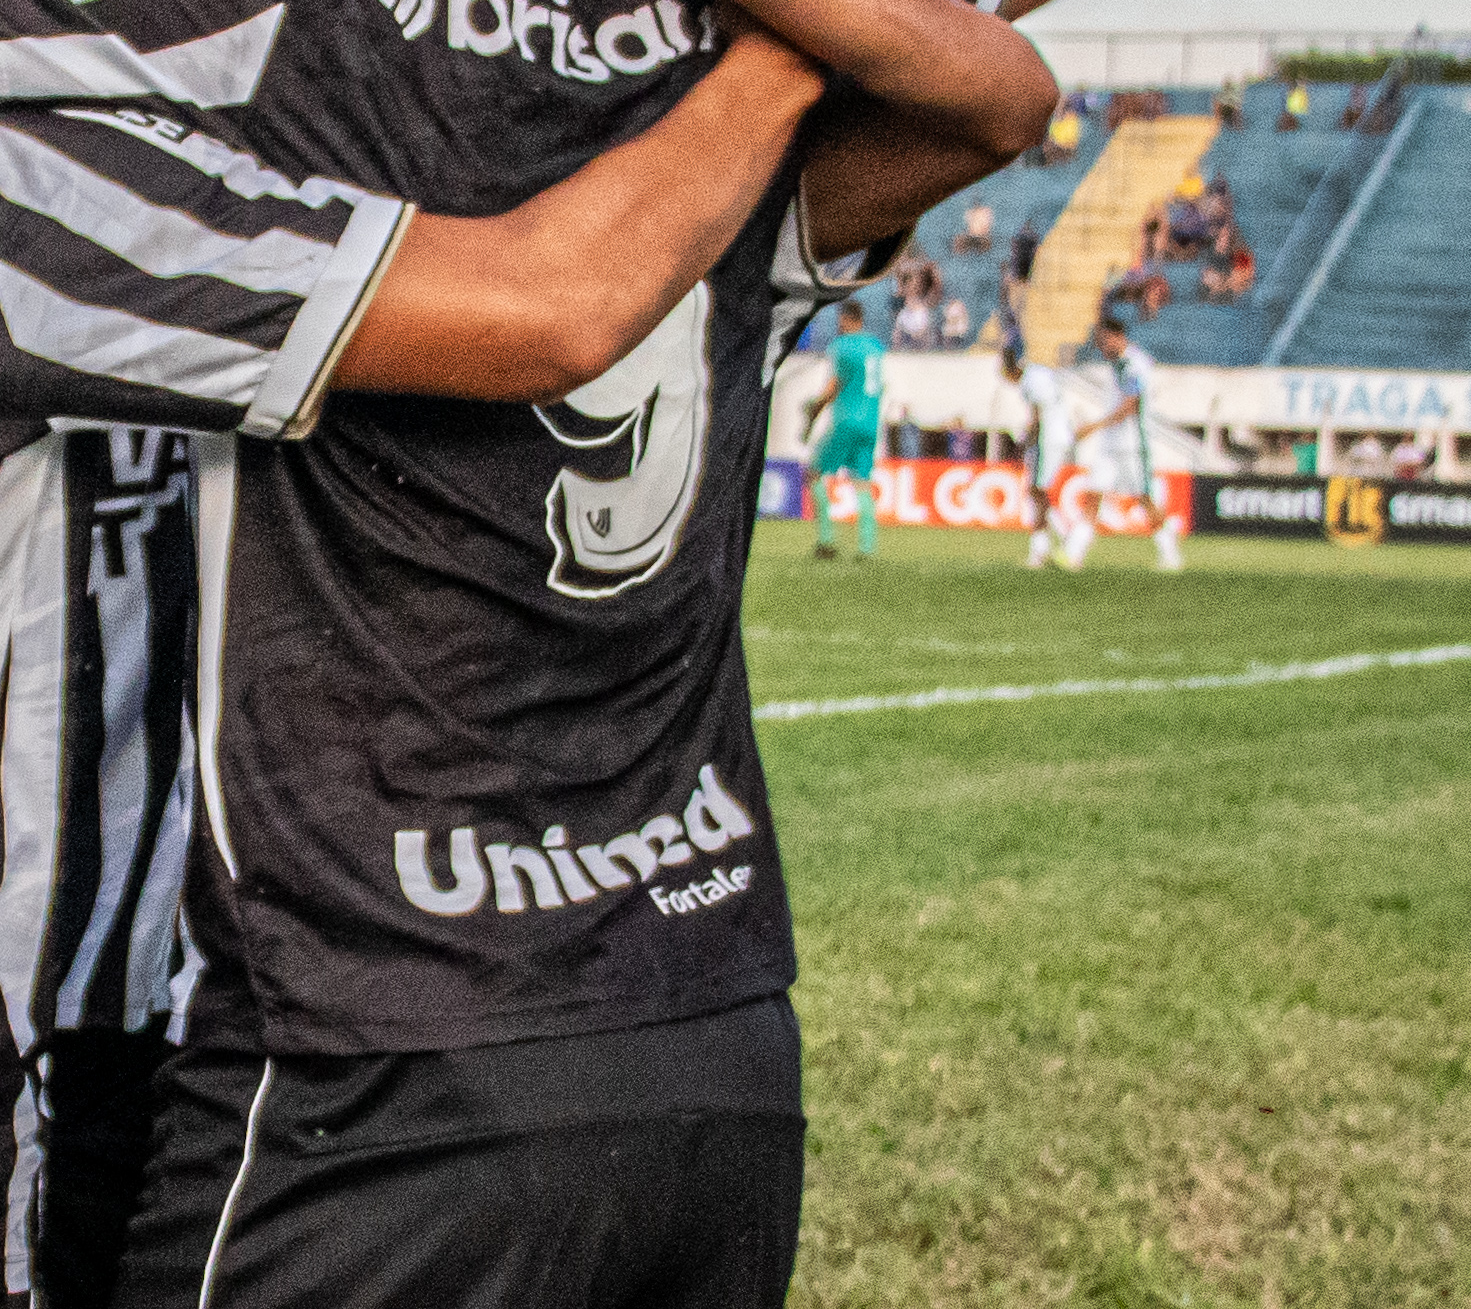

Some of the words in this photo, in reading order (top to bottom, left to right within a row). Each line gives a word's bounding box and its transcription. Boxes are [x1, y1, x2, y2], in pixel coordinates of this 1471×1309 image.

[1283, 373, 1449, 418] TRAGA
[1216, 486, 1322, 520] smart
[647, 863, 754, 918] Fortale
